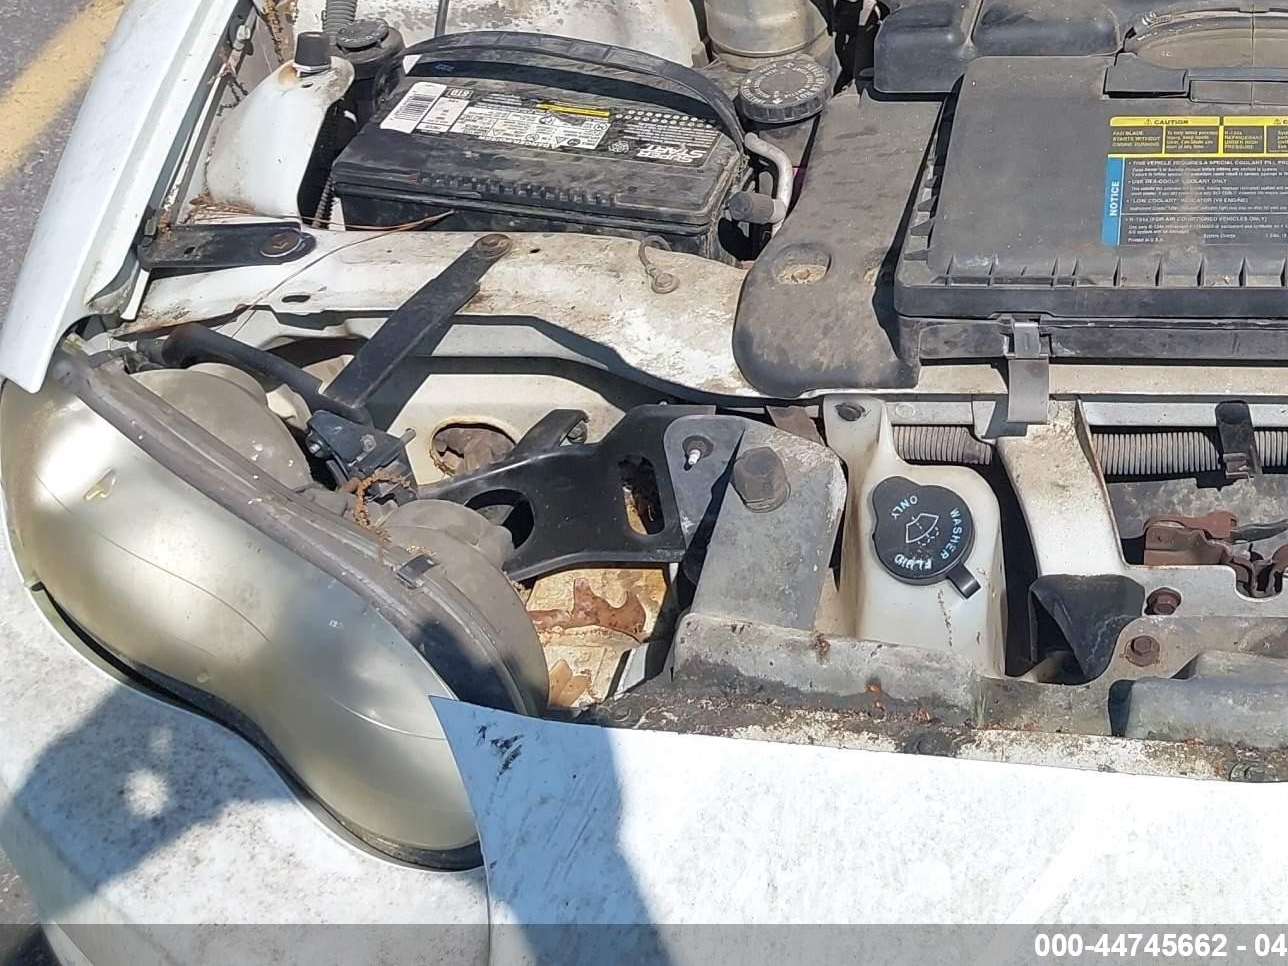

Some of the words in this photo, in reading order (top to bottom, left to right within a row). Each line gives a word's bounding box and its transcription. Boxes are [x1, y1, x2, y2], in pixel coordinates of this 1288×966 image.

[636, 150, 693, 163] SUPER
[638, 143, 707, 159] START
[1109, 181, 1120, 217] NOTICE
[890, 494, 918, 521] ONLY
[939, 507, 963, 560] WASHER
[893, 553, 933, 571] FLUID
